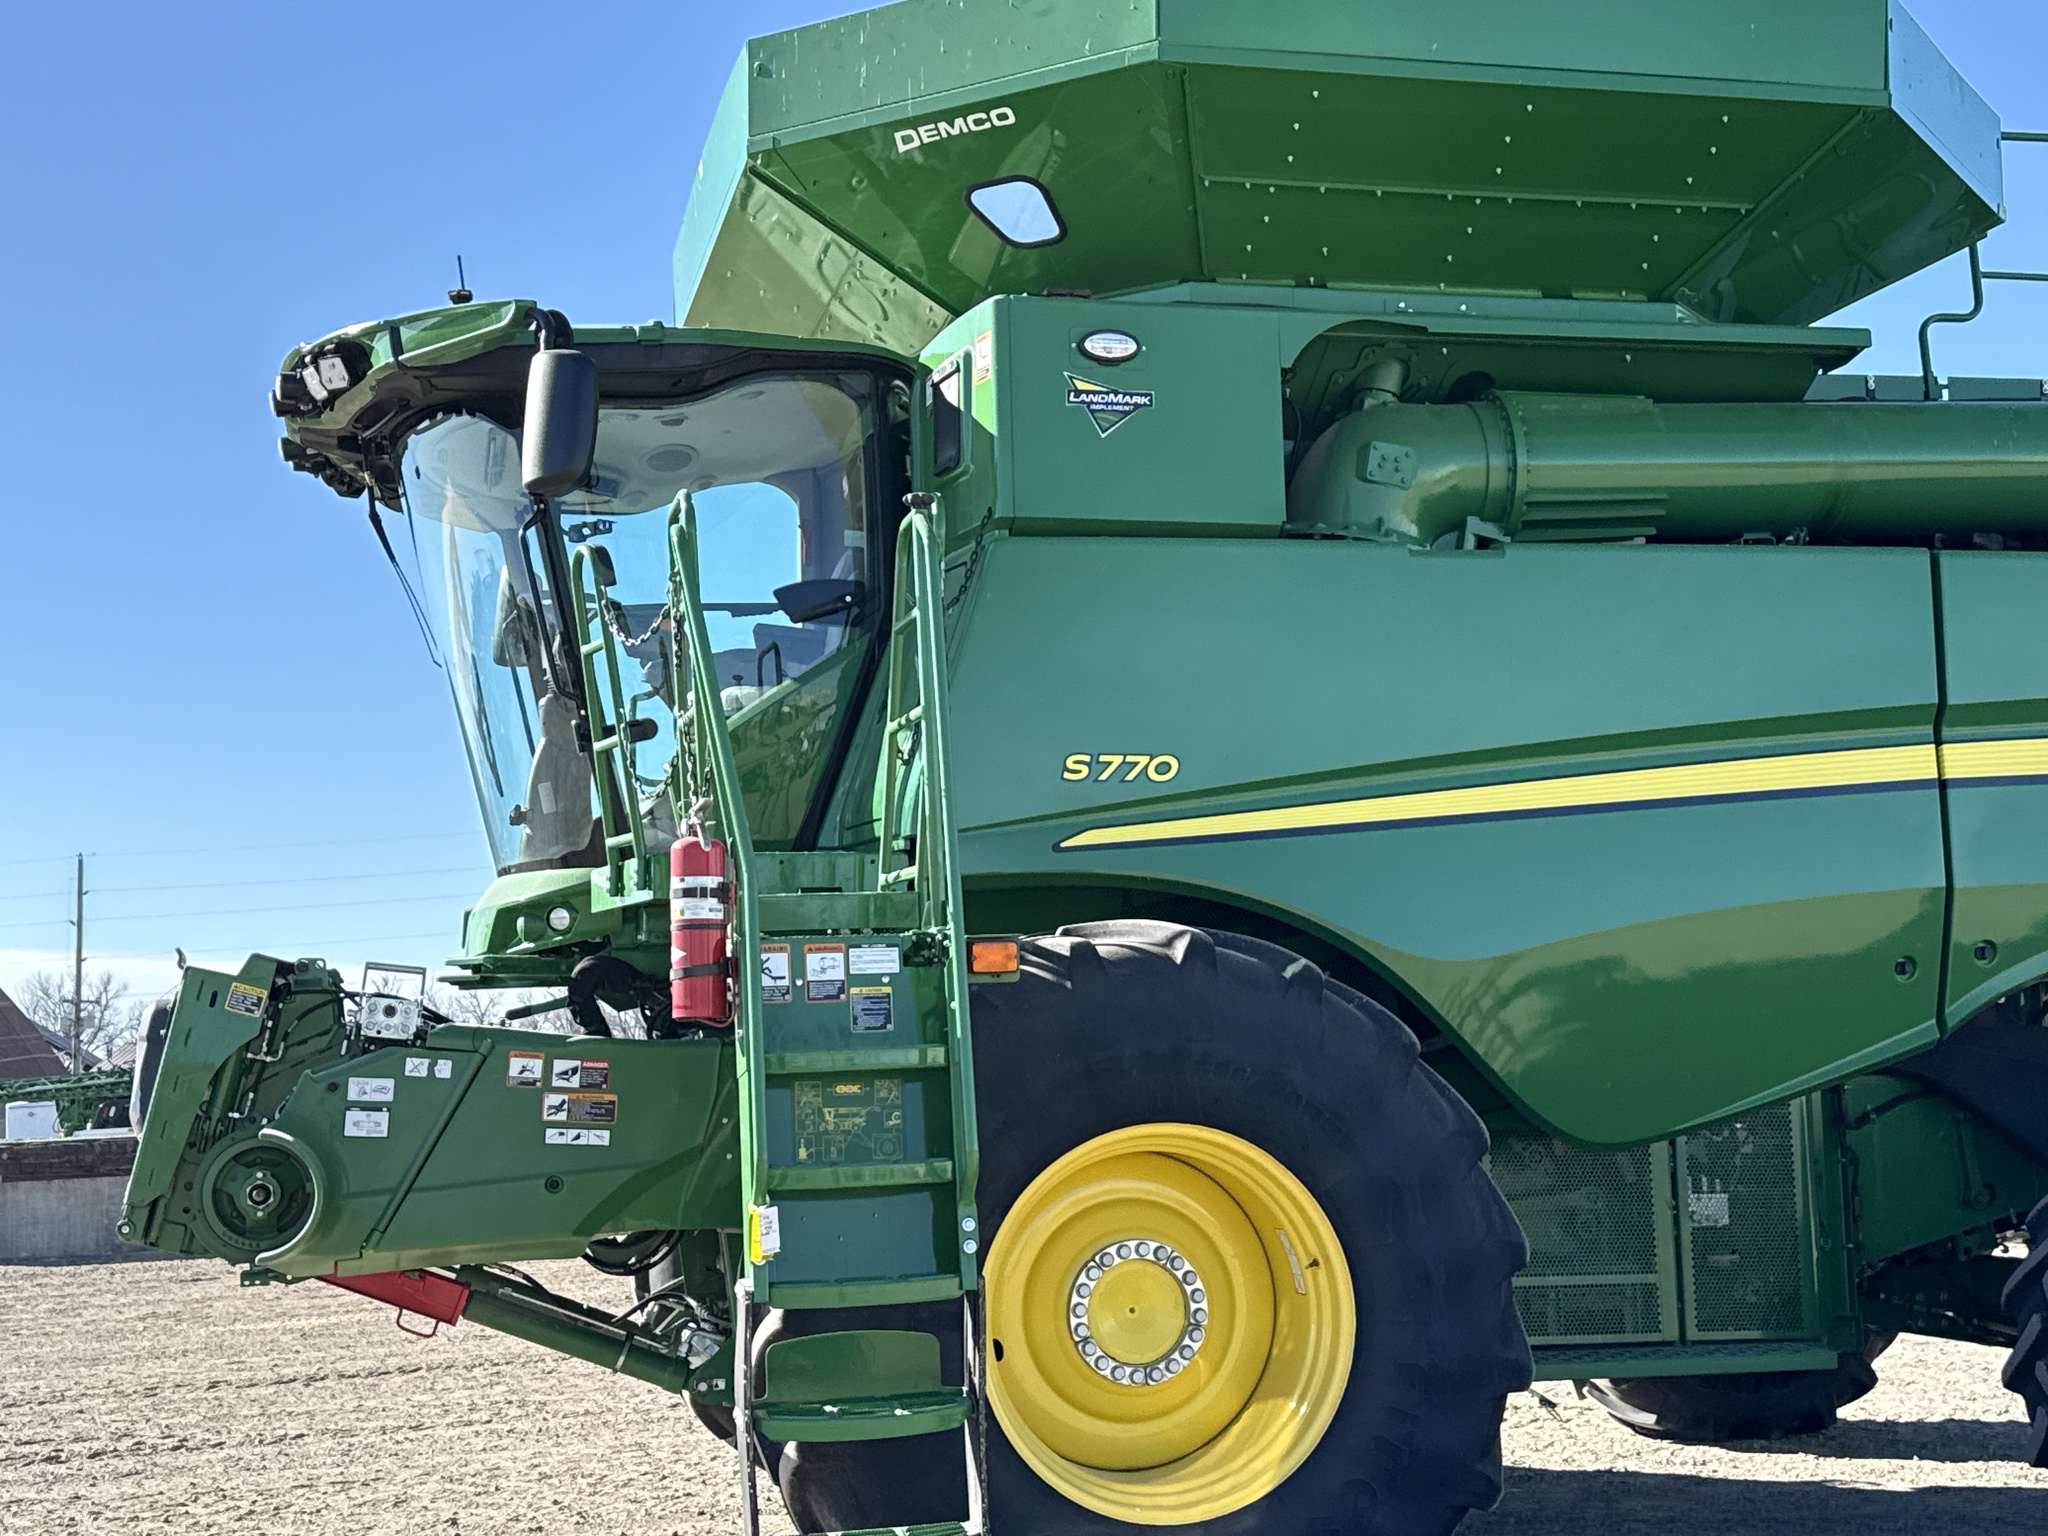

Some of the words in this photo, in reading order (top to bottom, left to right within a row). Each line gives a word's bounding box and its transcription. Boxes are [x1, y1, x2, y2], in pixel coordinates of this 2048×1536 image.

[893, 106, 1016, 154] DEMCO
[1089, 403, 1135, 411] IMPLEMENT
[1060, 753, 1180, 783] S770
